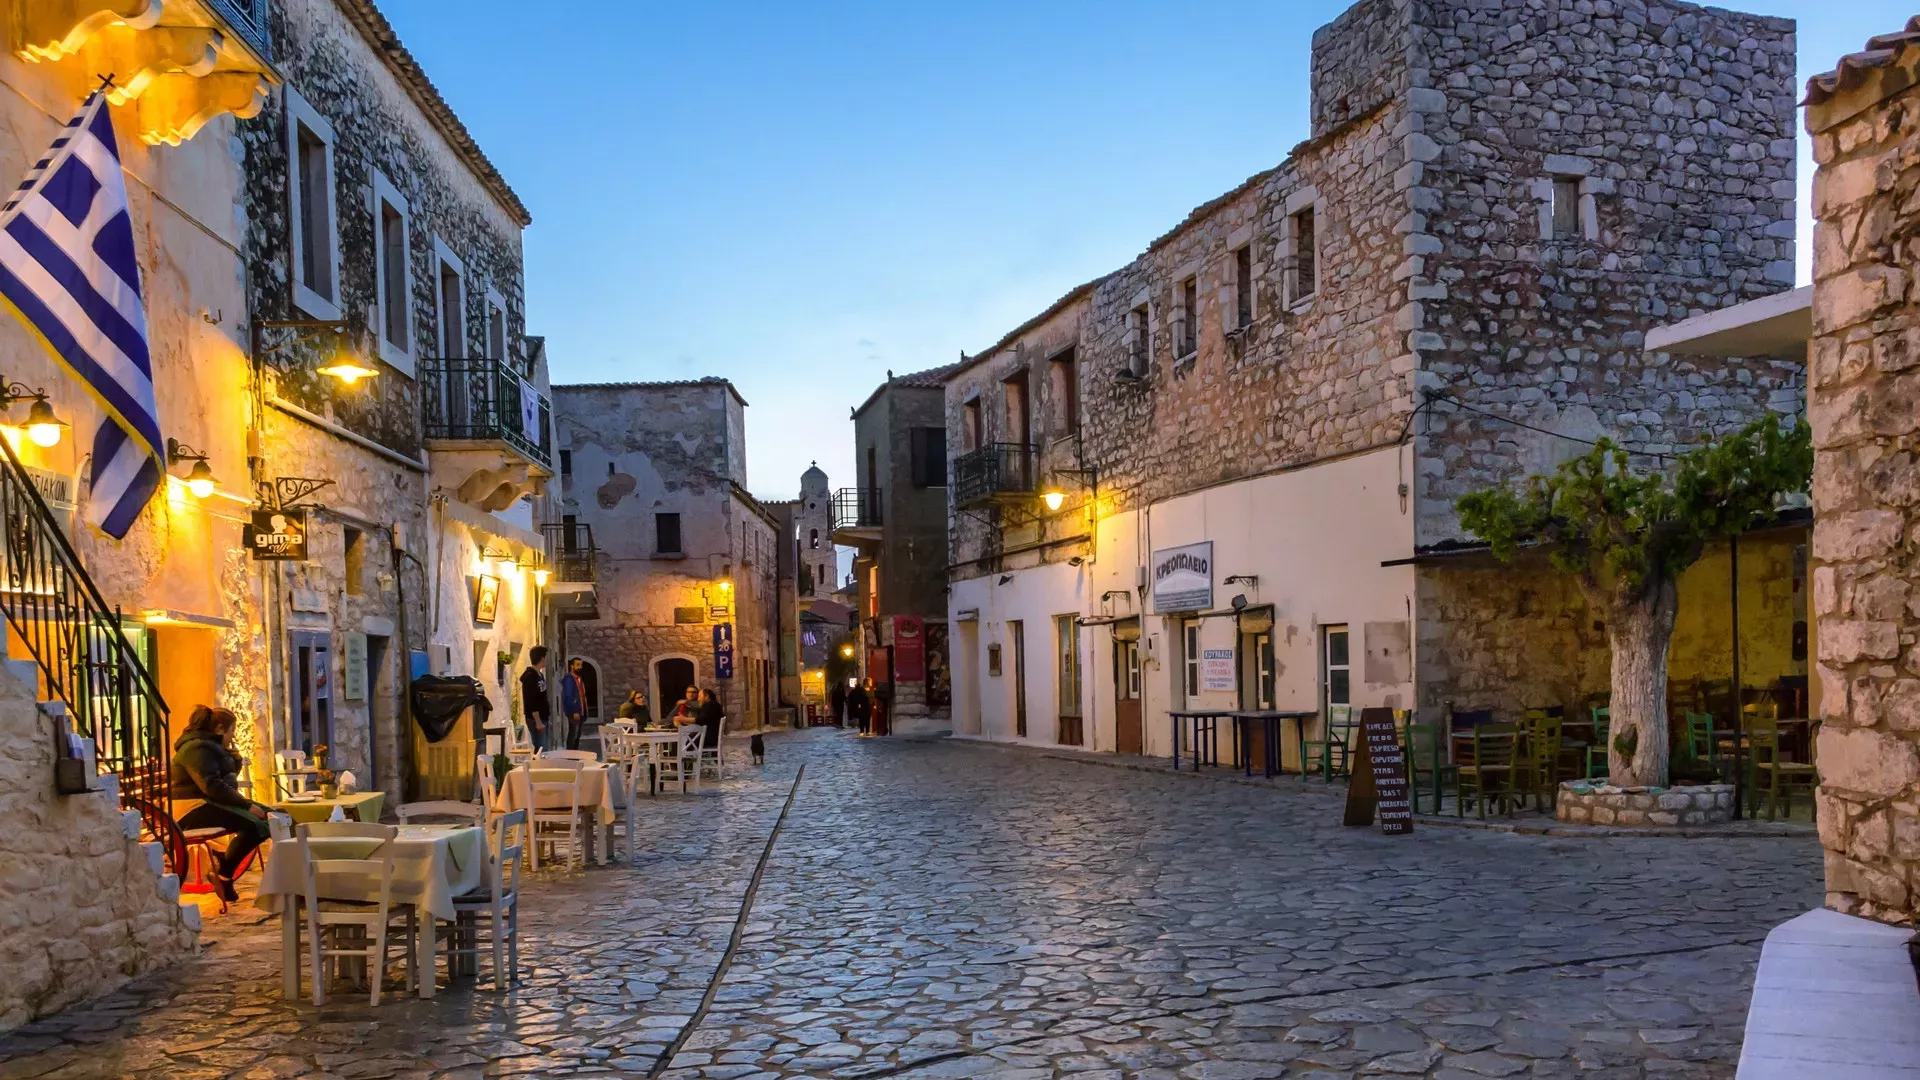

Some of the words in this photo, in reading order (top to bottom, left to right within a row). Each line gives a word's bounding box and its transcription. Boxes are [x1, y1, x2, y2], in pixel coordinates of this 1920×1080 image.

[255, 534, 302, 547] gima
[1156, 552, 1208, 580] ΚΡΕΟΠΩΛΕΙΟ
[718, 644, 730, 652] 20
[719, 656, 729, 669] P
[1377, 789, 1401, 797] TOAST
